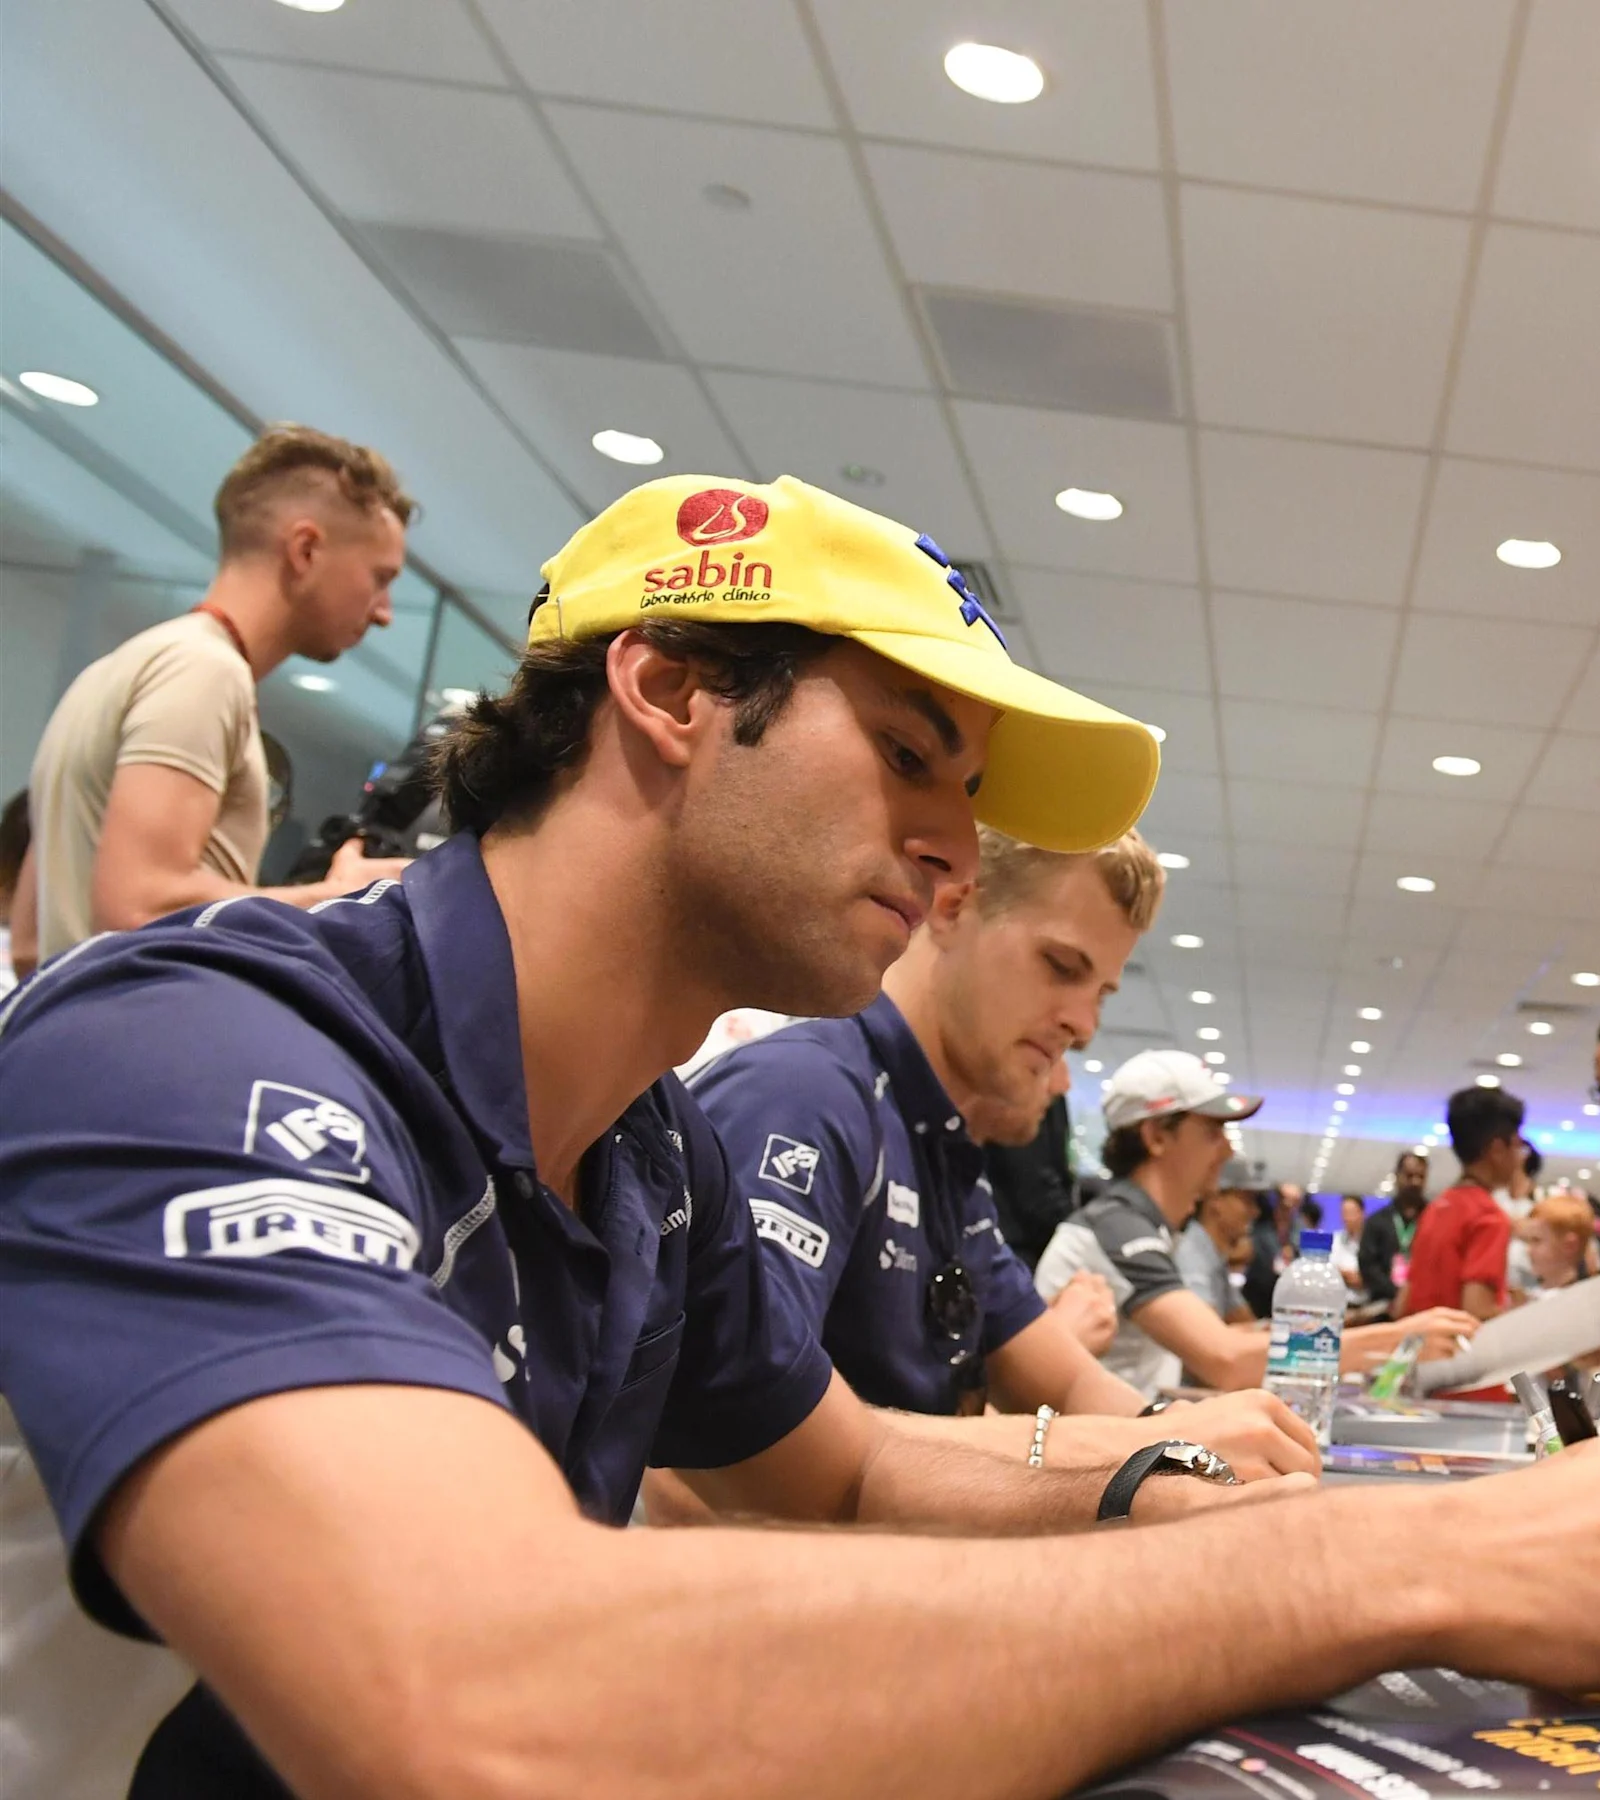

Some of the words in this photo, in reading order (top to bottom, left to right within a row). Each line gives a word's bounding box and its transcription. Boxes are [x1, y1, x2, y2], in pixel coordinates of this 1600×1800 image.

[644, 550, 772, 592] sabin
[264, 1100, 361, 1161] IFS
[771, 1143, 817, 1179] IFS
[178, 1188, 410, 1269] PIRELL
[749, 1202, 826, 1264] RELLI
